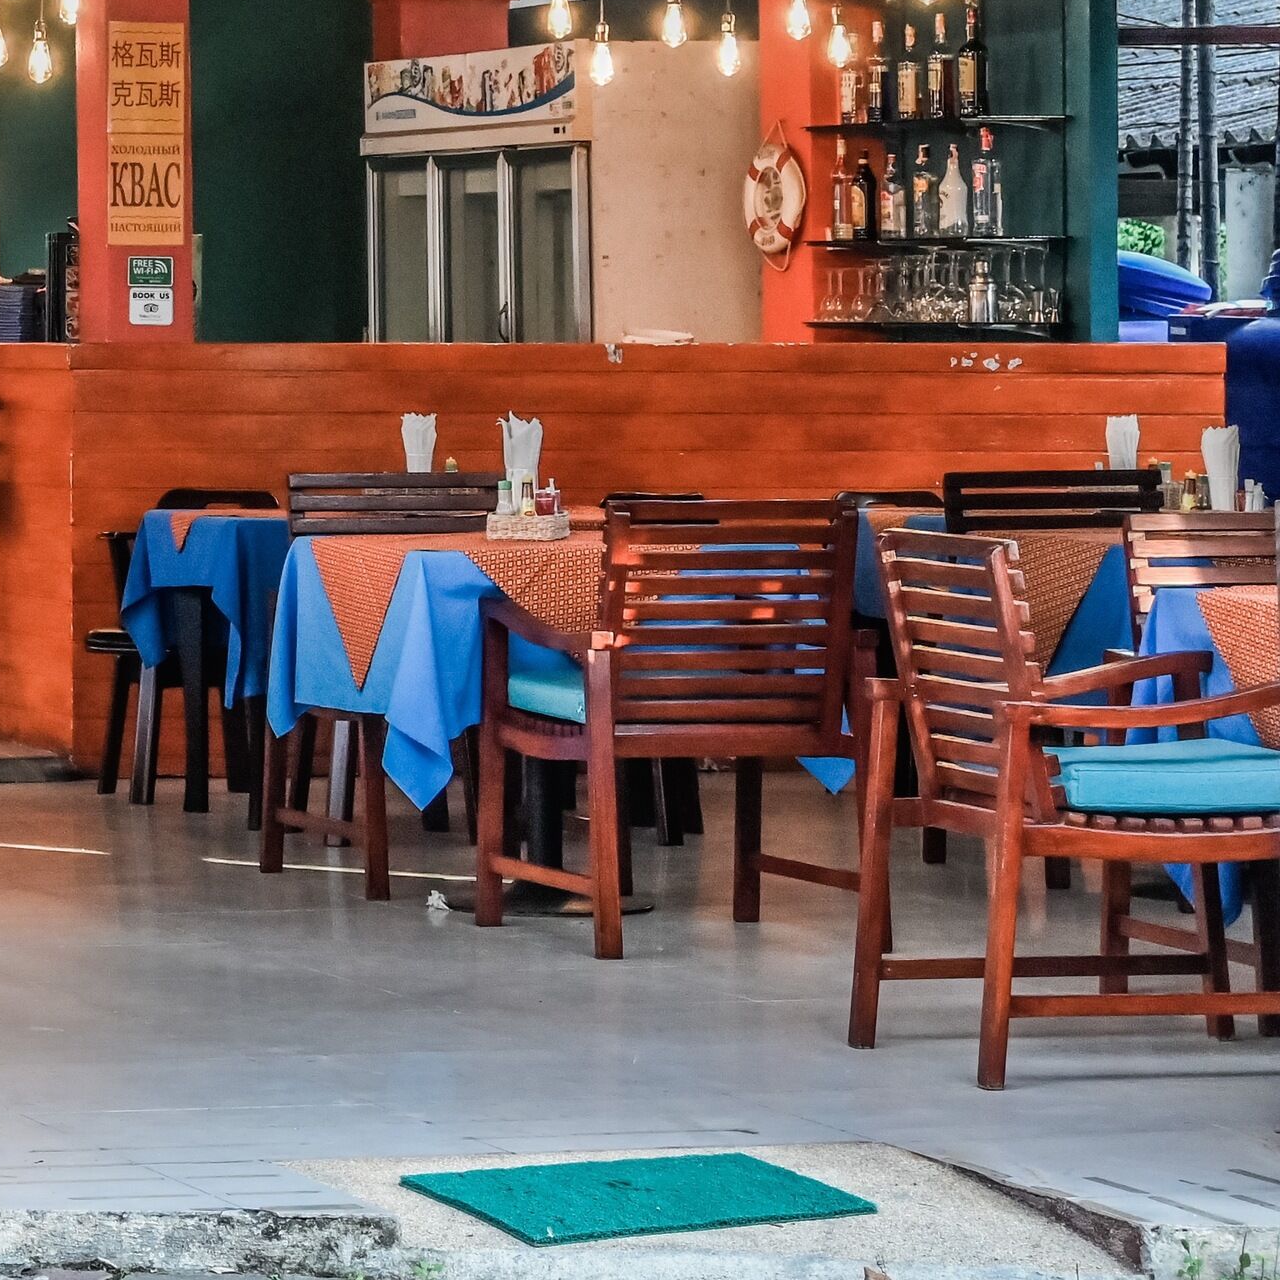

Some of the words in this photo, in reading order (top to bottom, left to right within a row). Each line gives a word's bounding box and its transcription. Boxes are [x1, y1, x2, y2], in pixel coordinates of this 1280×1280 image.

[111, 40, 182, 69] 格瓦斯
[111, 80, 182, 109] 克瓦斯
[111, 144, 181, 155] ХОЛОДНЫЙ
[110, 162, 181, 208] КВАС
[110, 222, 182, 233] НАСТОЯЩИЙ
[132, 259, 154, 267] FREE
